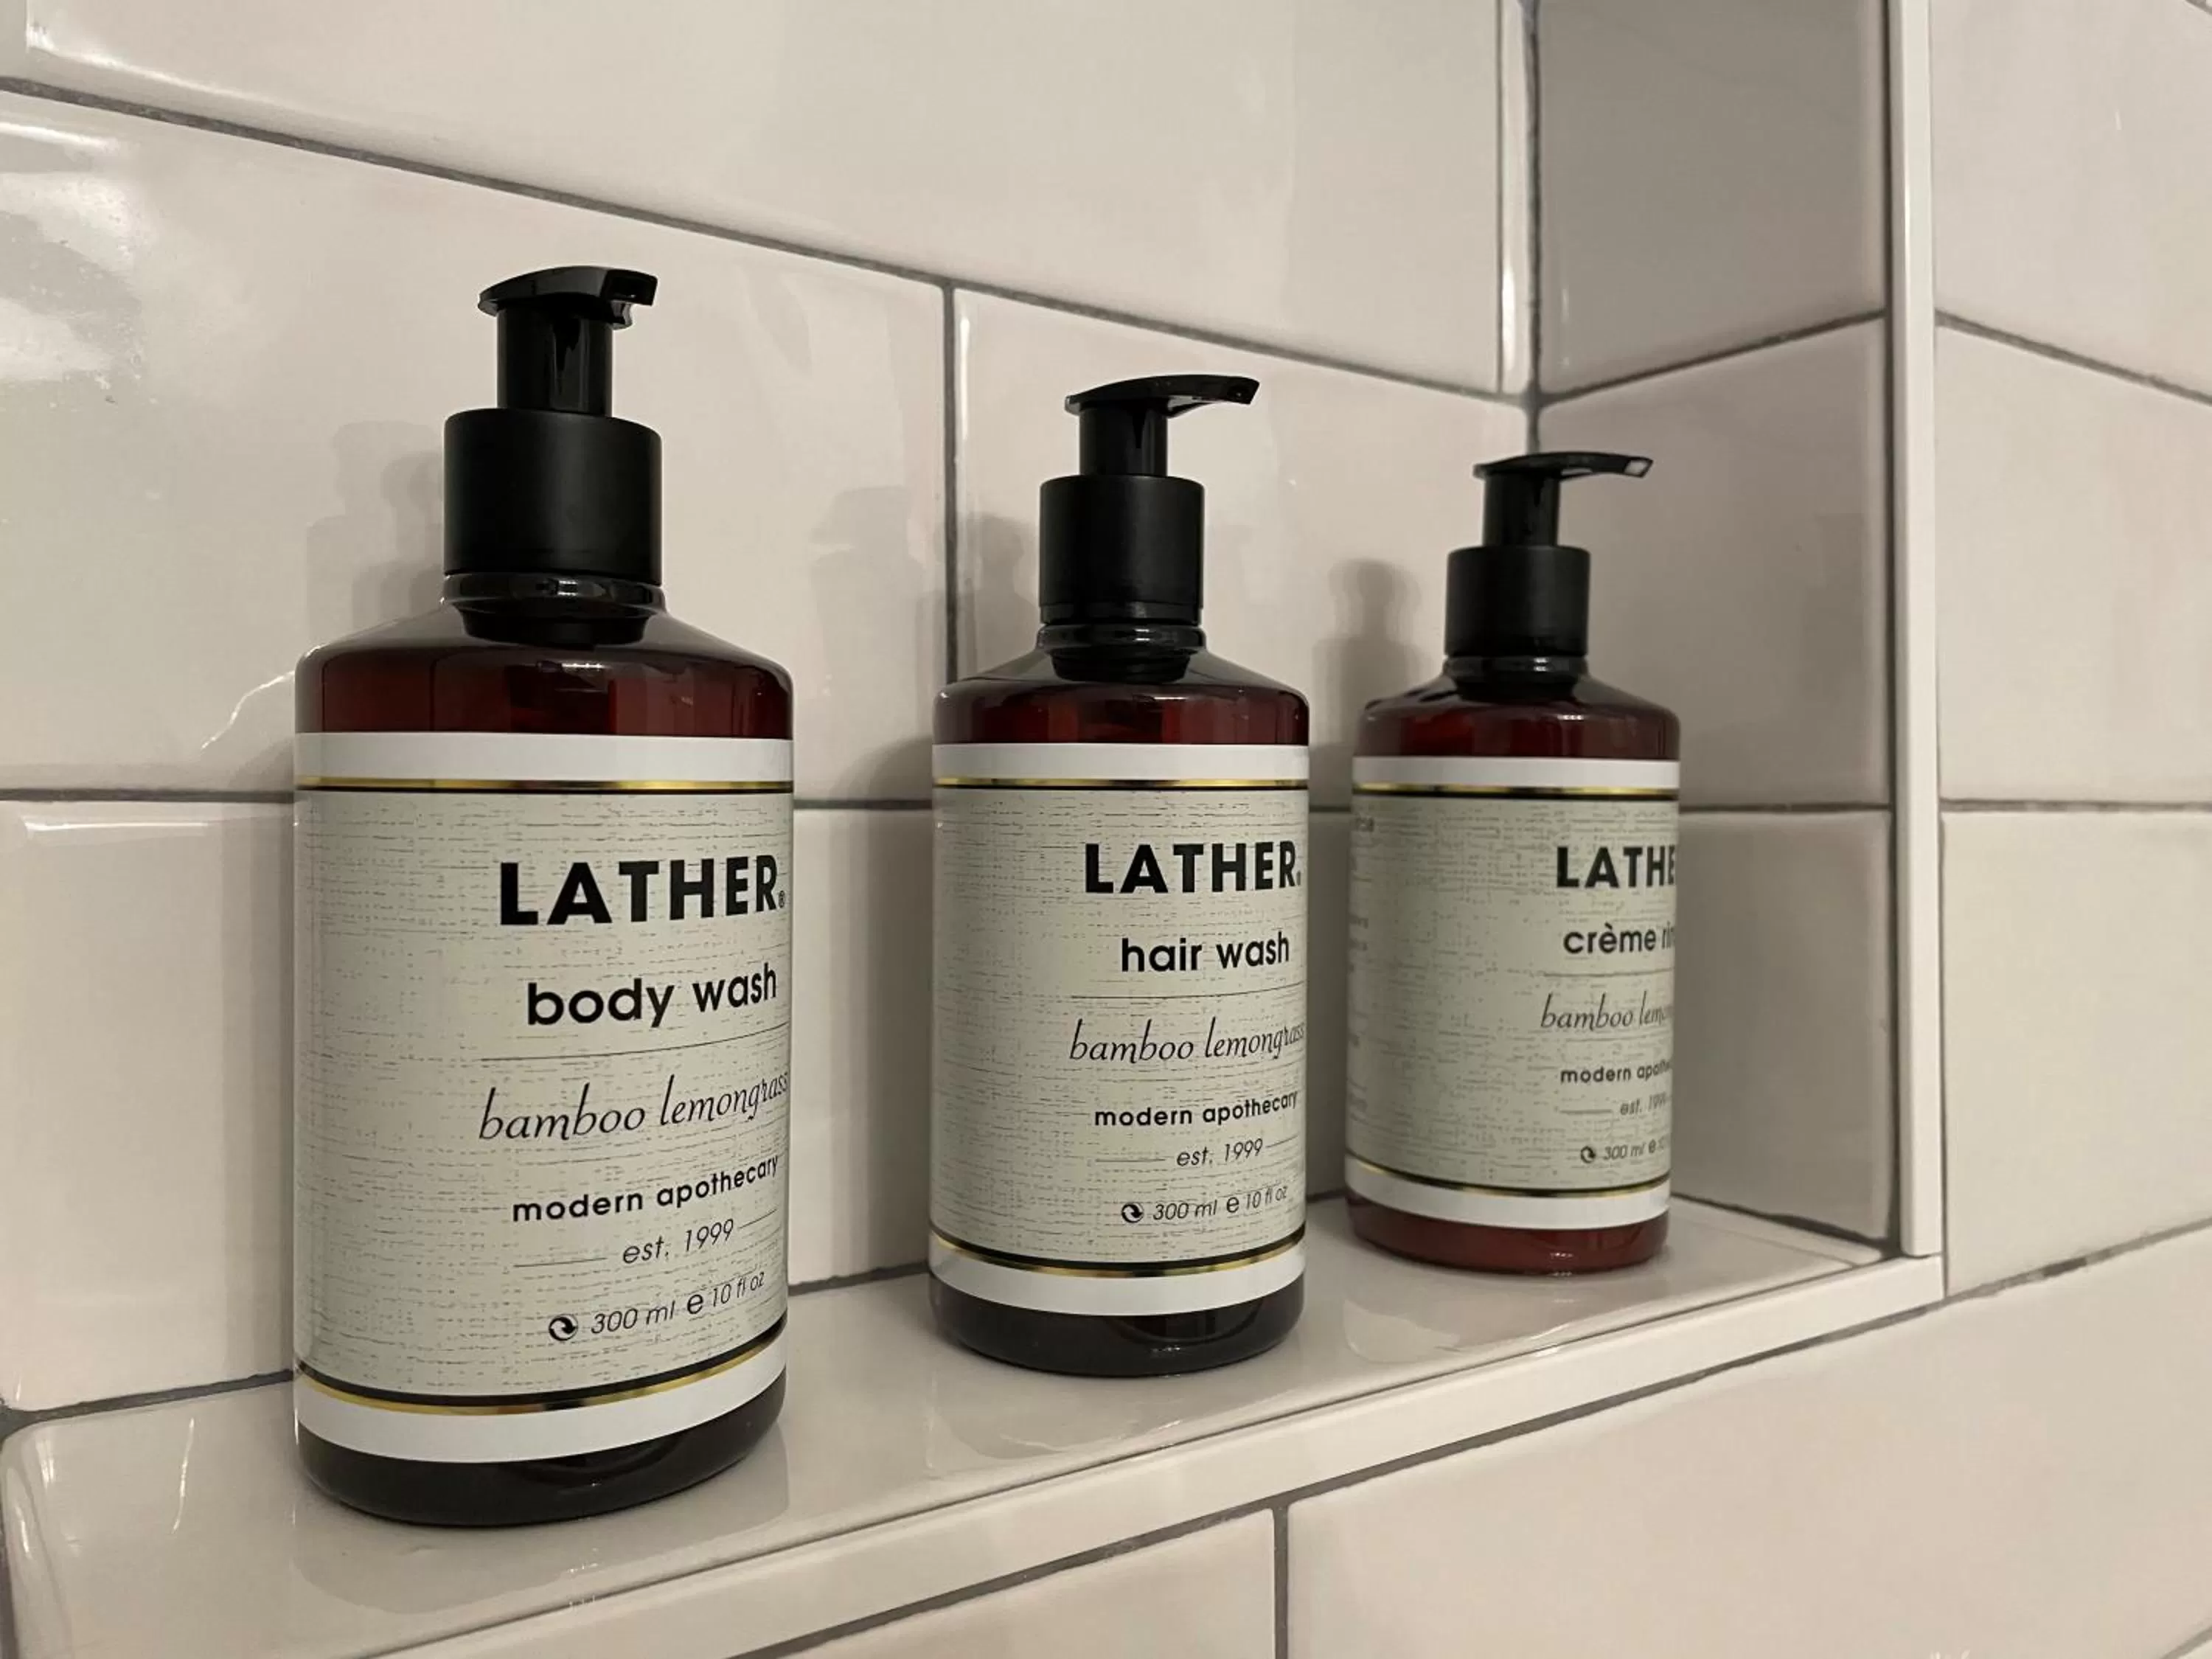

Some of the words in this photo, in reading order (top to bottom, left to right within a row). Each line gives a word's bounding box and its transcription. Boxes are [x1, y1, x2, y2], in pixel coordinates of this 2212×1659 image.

[1121, 938, 1203, 973] hair
[1217, 932, 1290, 969] wash
[1563, 923, 1657, 954] crème
[528, 978, 675, 1028] body
[692, 962, 777, 1013] wash
[1540, 993, 1634, 1032] bamboo
[1069, 1018, 1194, 1063] bamboo
[1560, 1065, 1632, 1083] modern
[479, 1082, 646, 1141] bamboo
[1094, 1108, 1193, 1127] modern
[1203, 1091, 1298, 1125] apothecary
[1177, 1146, 1214, 1166] est.
[1224, 1138, 1264, 1163] 1999
[513, 1194, 643, 1222] modern
[657, 1153, 779, 1209] apothecary
[1152, 1203, 1189, 1220] 300
[1194, 1199, 1217, 1218] ml
[1246, 1191, 1262, 1211] 10
[623, 1236, 669, 1265] est.
[685, 1218, 734, 1252] 1999
[591, 1308, 638, 1335] 300
[645, 1300, 675, 1326] ml
[712, 1283, 732, 1307] 10
[750, 1271, 765, 1291] oz
